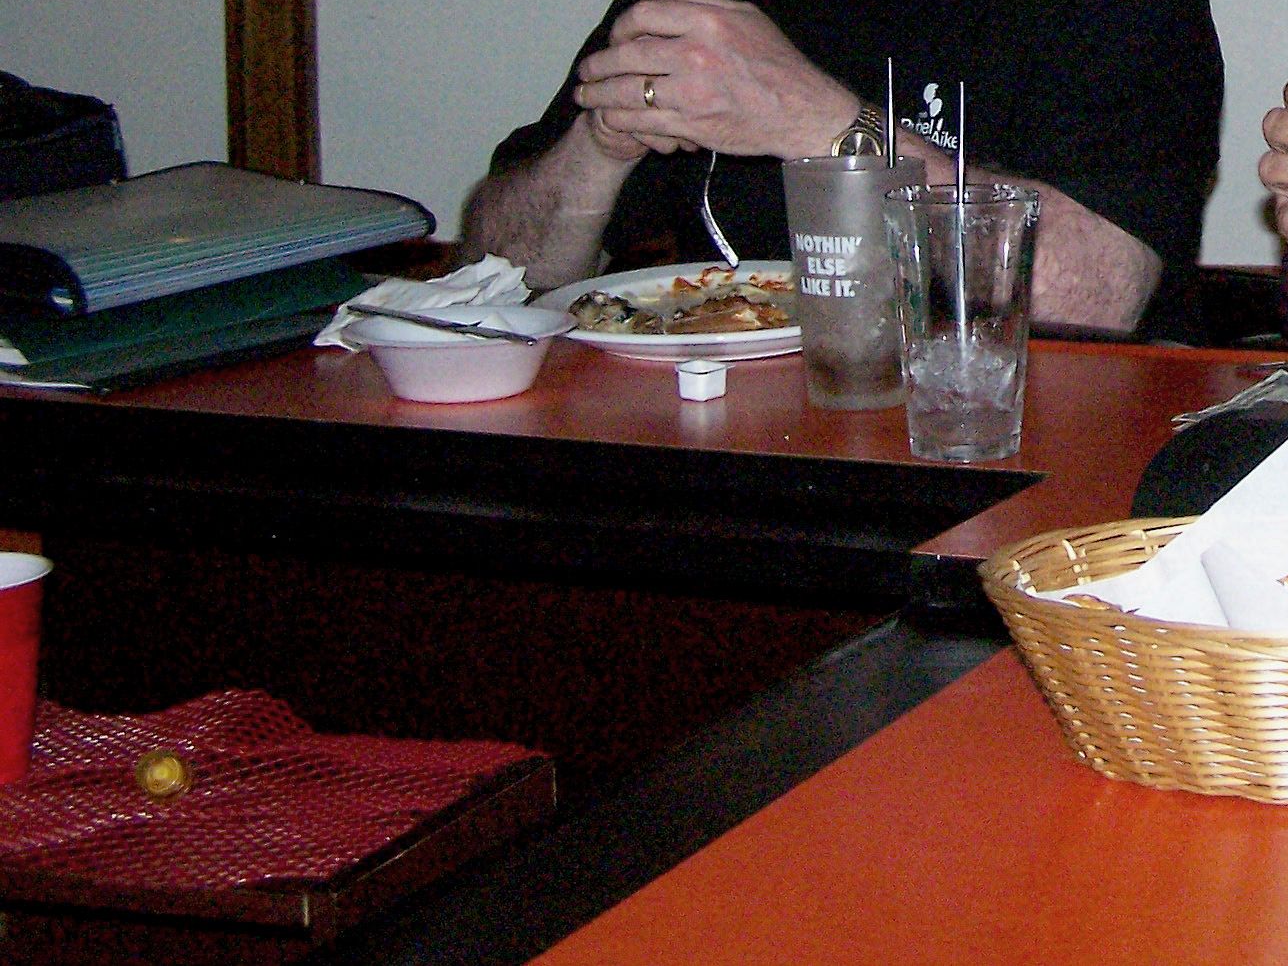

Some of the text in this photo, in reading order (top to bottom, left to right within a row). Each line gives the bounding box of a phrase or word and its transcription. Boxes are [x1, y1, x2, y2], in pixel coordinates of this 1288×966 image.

[796, 234, 863, 255] NOTHIN'
[807, 256, 846, 277] ELSE
[801, 277, 831, 297] LIKE
